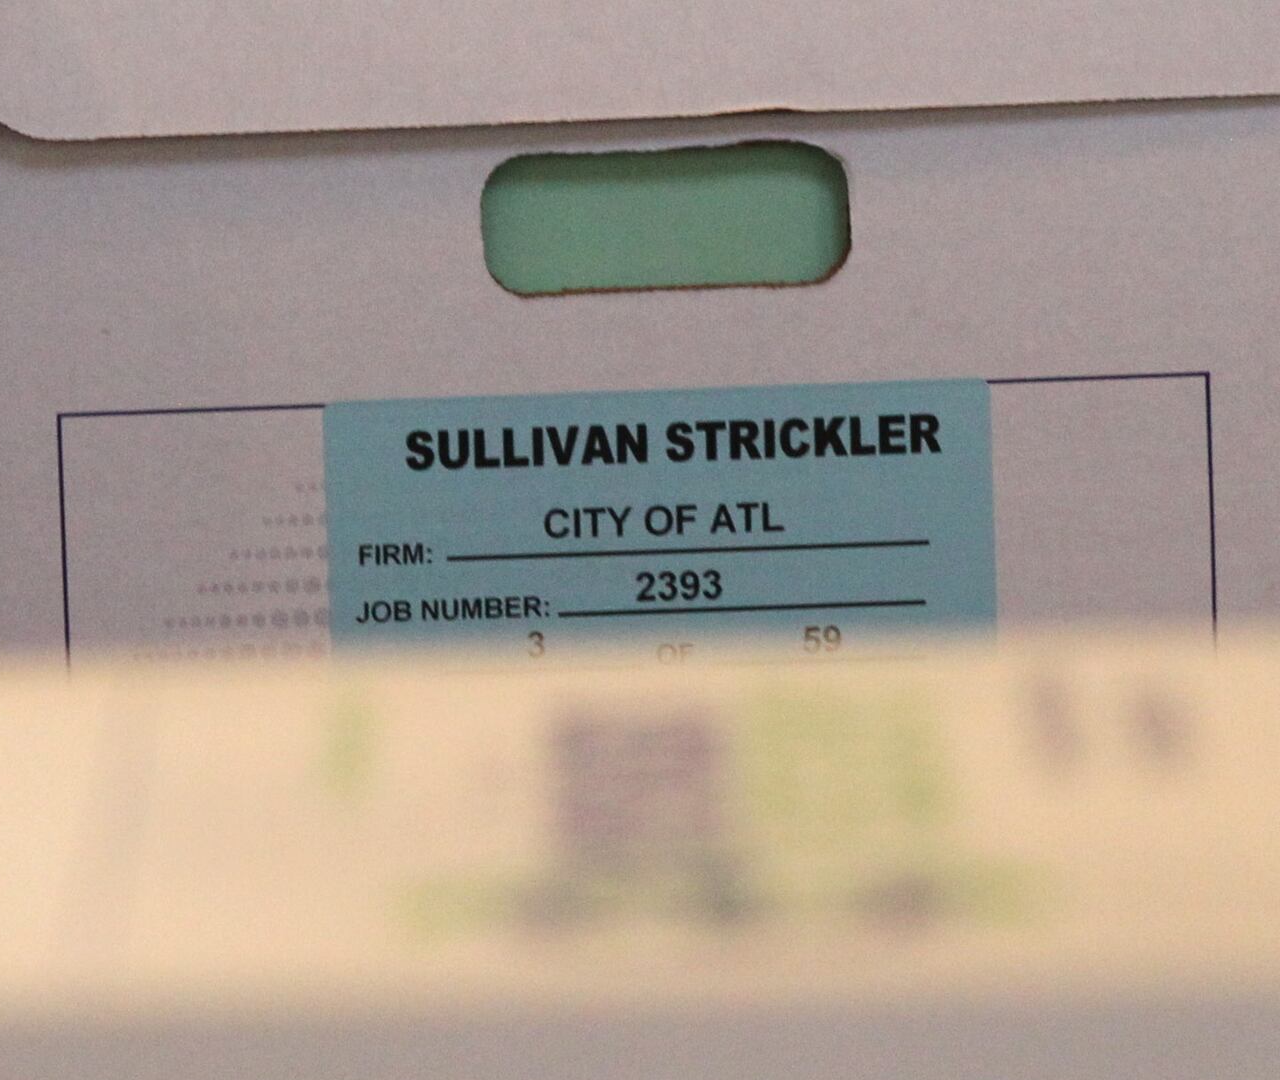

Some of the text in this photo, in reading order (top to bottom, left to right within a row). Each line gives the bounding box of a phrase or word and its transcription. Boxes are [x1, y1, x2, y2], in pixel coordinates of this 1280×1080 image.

[405, 413, 942, 472] SULLIVAN STRICKLER
[358, 501, 785, 567] FIRM: CITY OF ATL
[355, 569, 723, 624] JOB NUMBER: 2393
[528, 626, 841, 666] 3 OF 59
